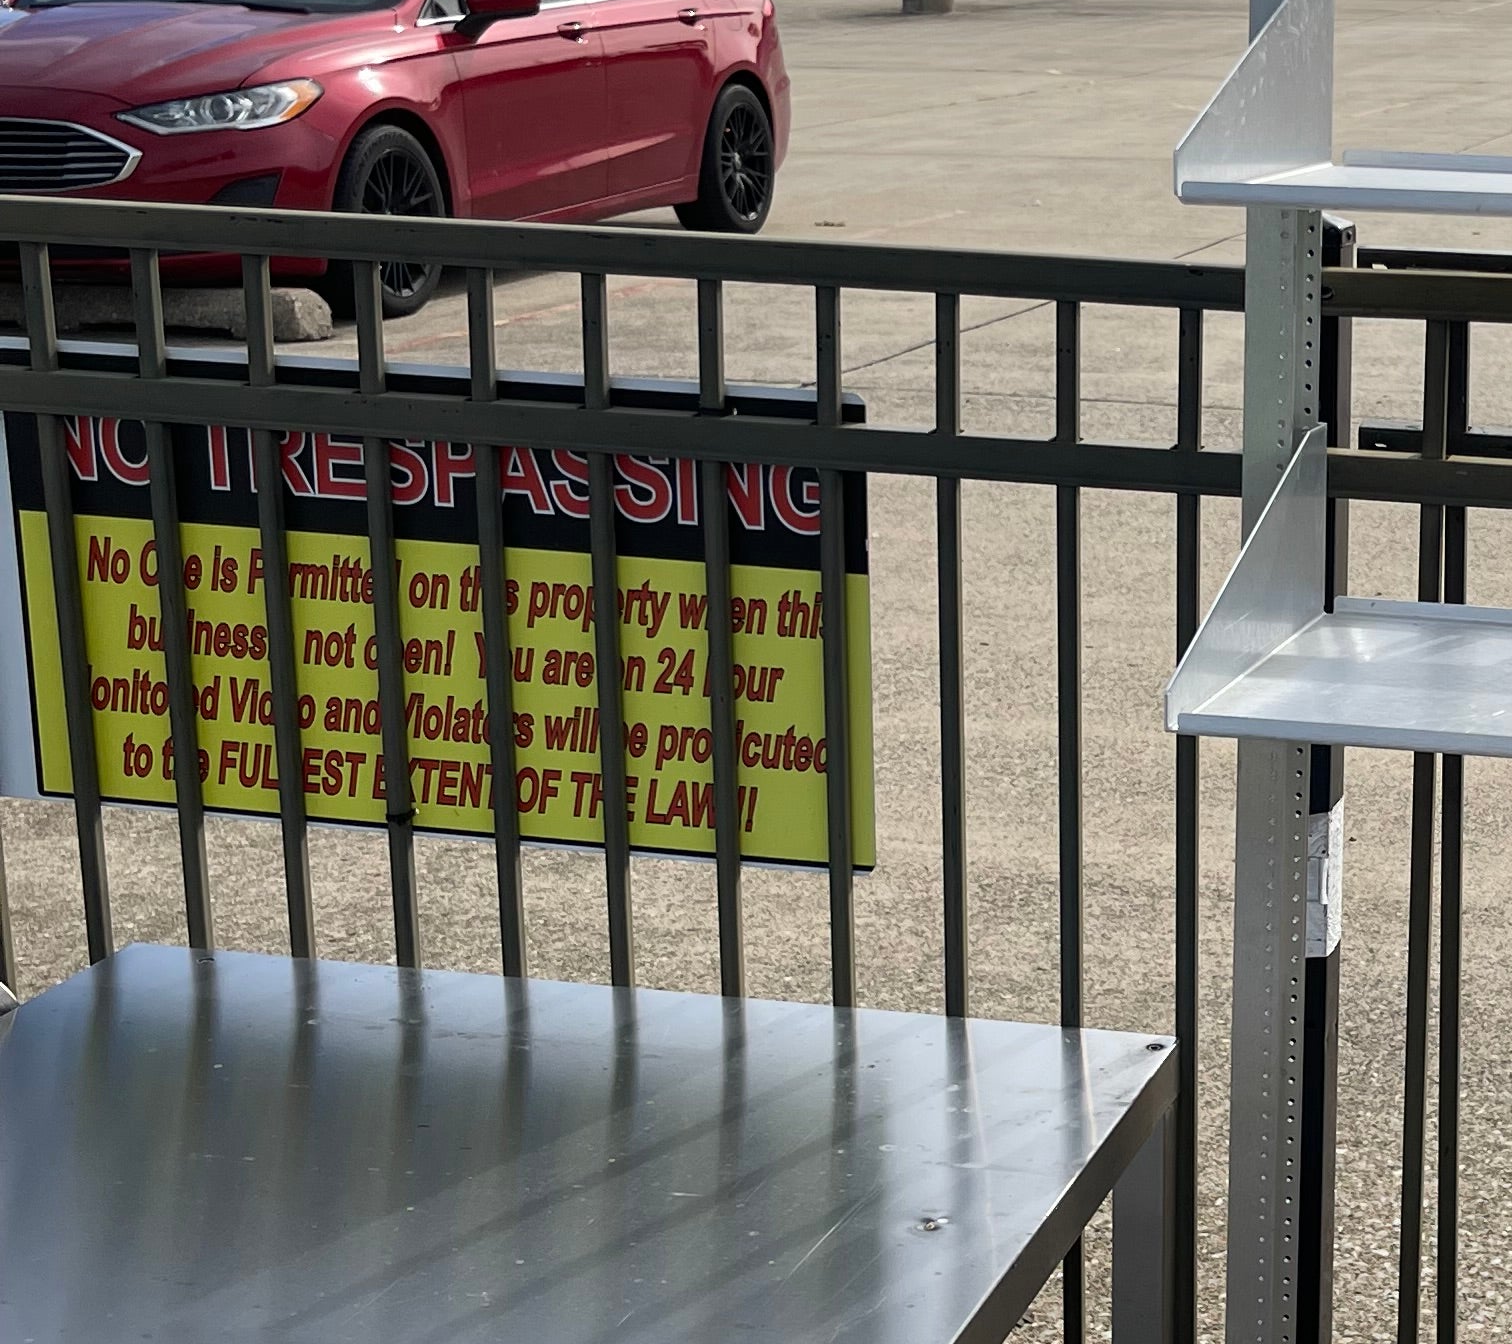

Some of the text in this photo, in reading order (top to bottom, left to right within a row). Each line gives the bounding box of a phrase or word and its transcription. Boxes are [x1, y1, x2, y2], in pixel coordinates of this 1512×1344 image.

[87, 536, 824, 639] No Oe is Prmitte on ths proprty wen thi
[128, 604, 268, 660] buiness
[304, 623, 357, 668] not
[364, 630, 455, 676] oen!
[474, 631, 534, 684] Yu
[542, 649, 594, 688] are
[621, 656, 646, 692] n
[653, 647, 695, 696] 24
[88, 664, 828, 771] onitod Vido and iolats will e proicute
[123, 732, 153, 778] to
[163, 736, 209, 784] te
[219, 740, 366, 798] FULEST
[516, 767, 562, 814] OF
